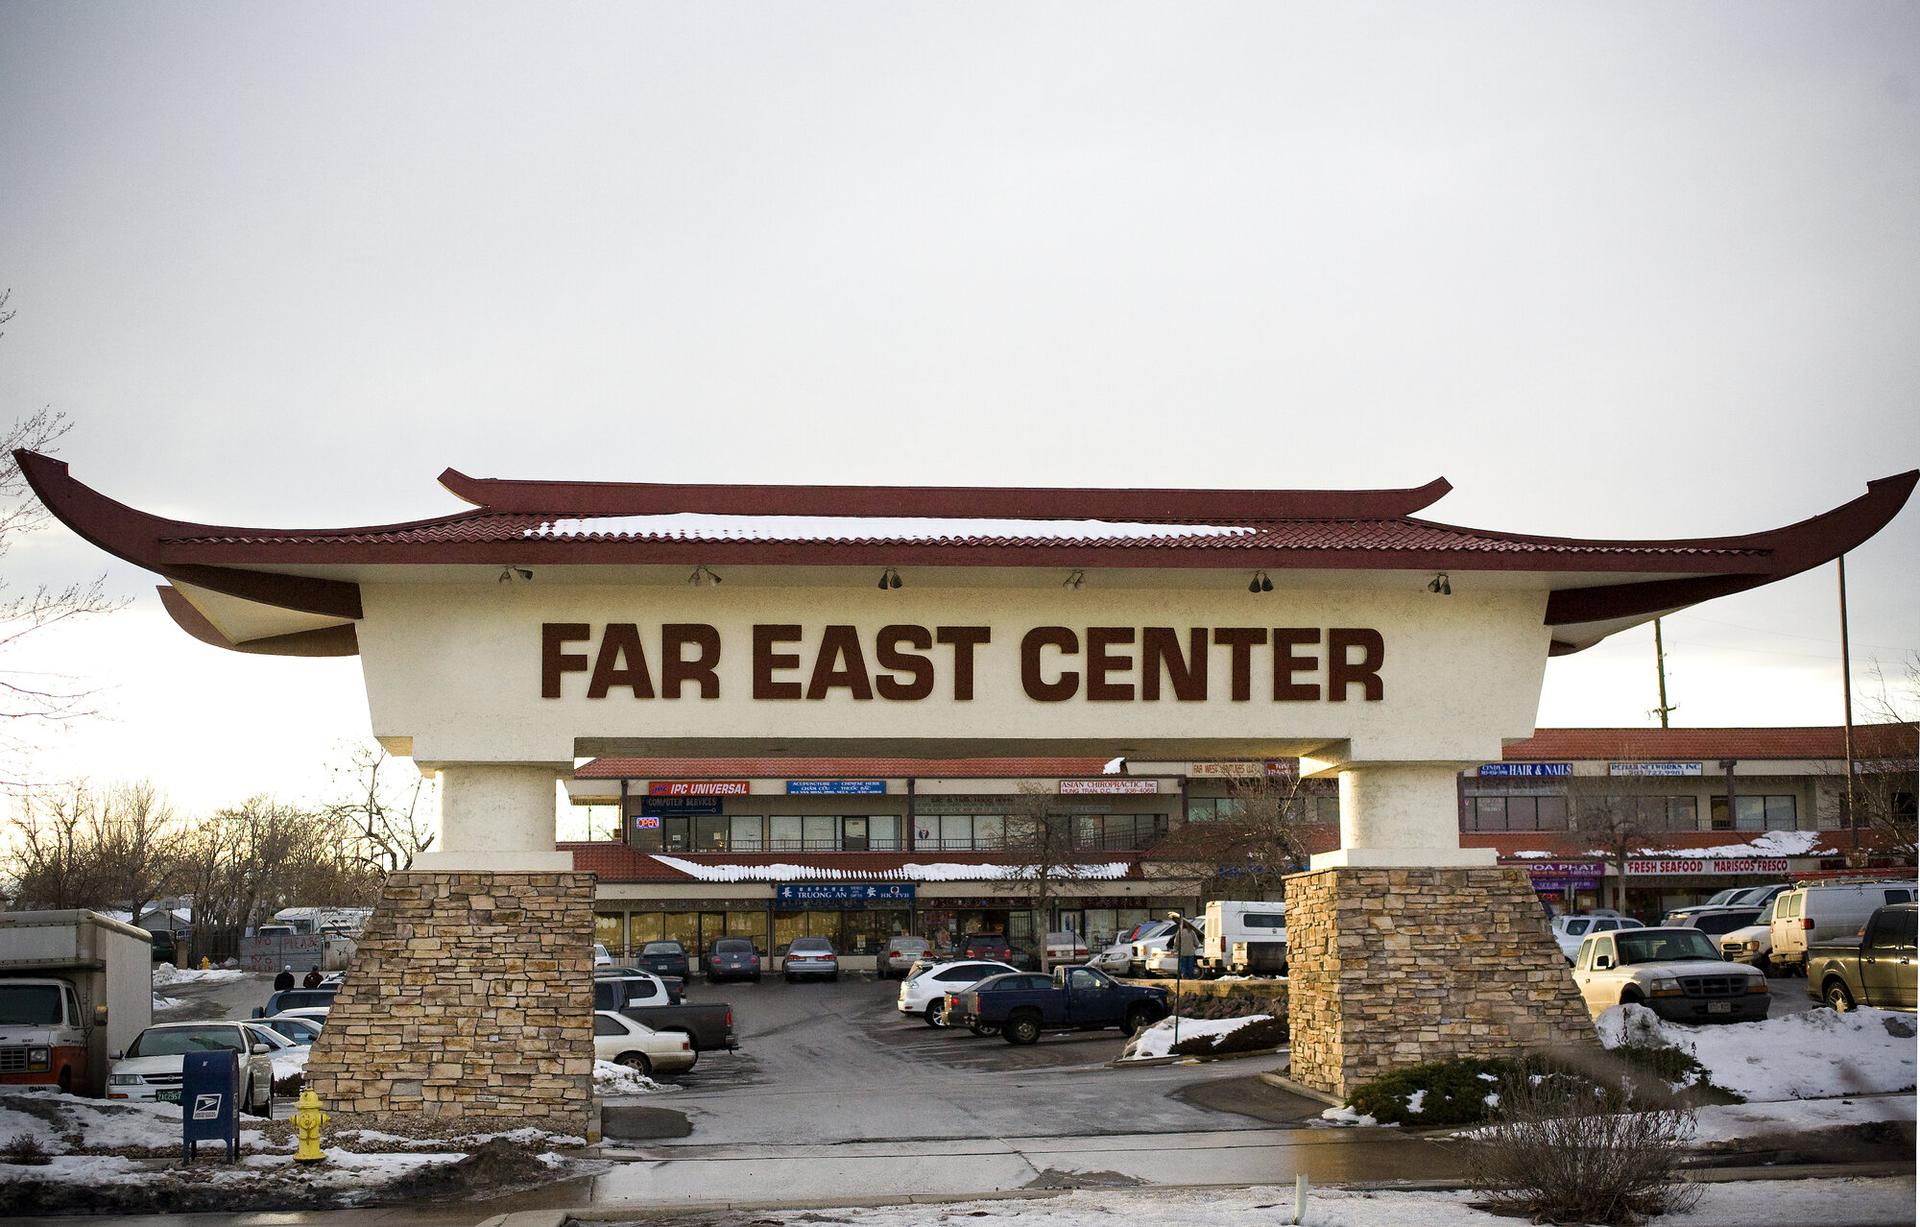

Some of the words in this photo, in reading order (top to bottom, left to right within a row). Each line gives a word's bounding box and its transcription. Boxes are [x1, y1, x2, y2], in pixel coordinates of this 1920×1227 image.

[542, 623, 721, 699] FAR
[752, 624, 991, 701] EAST
[1020, 626, 1385, 702] CENTER
[1509, 764, 1532, 776] HAIR
[1535, 764, 1542, 775] &
[1545, 764, 1572, 775] NAILS
[670, 783, 689, 794] IPC
[690, 783, 747, 794] UNIVERSAL
[648, 798, 683, 807] COMPUTER
[686, 798, 718, 807] SERVICES
[638, 818, 658, 827] OPEN
[1628, 861, 1657, 873] FRESH
[1659, 860, 1703, 872] SEAFOOD
[1713, 860, 1755, 872] MARISCOS
[1757, 860, 1788, 872] FRESCO
